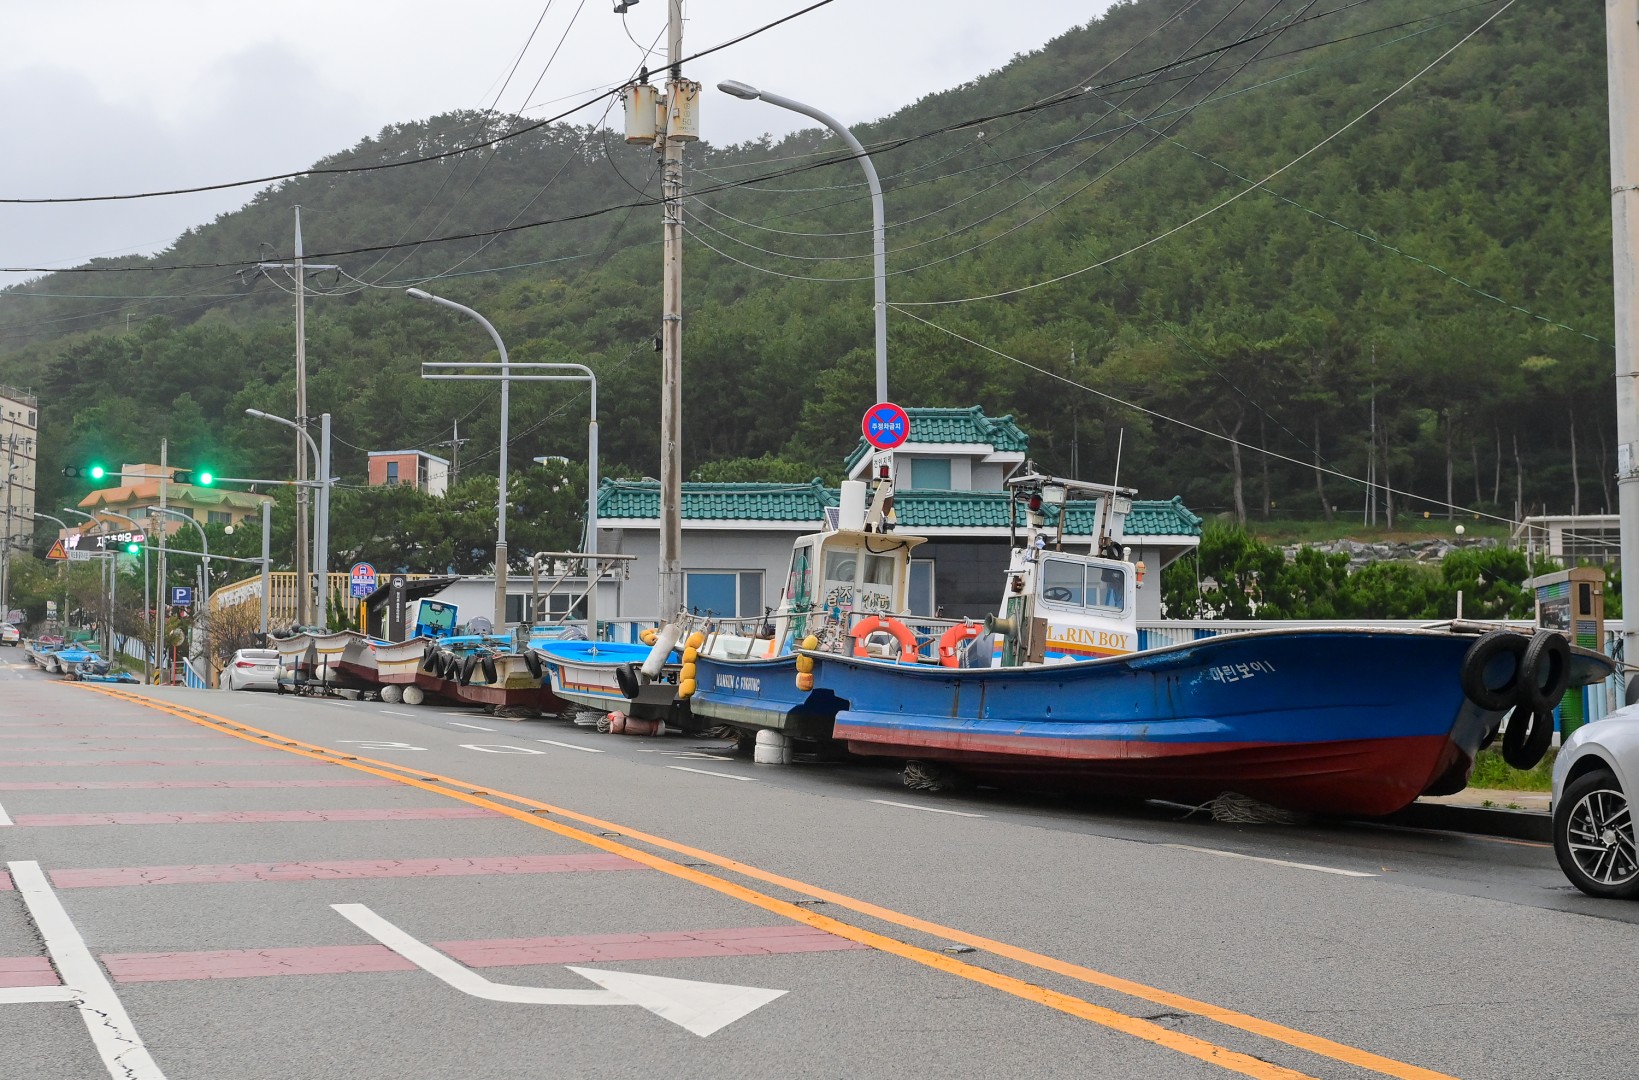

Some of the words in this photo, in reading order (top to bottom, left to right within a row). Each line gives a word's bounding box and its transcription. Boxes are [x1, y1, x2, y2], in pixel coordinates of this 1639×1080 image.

[872, 422, 901, 431] 주정차금지
[176, 588, 186, 600] P
[1099, 631, 1129, 649] BOY
